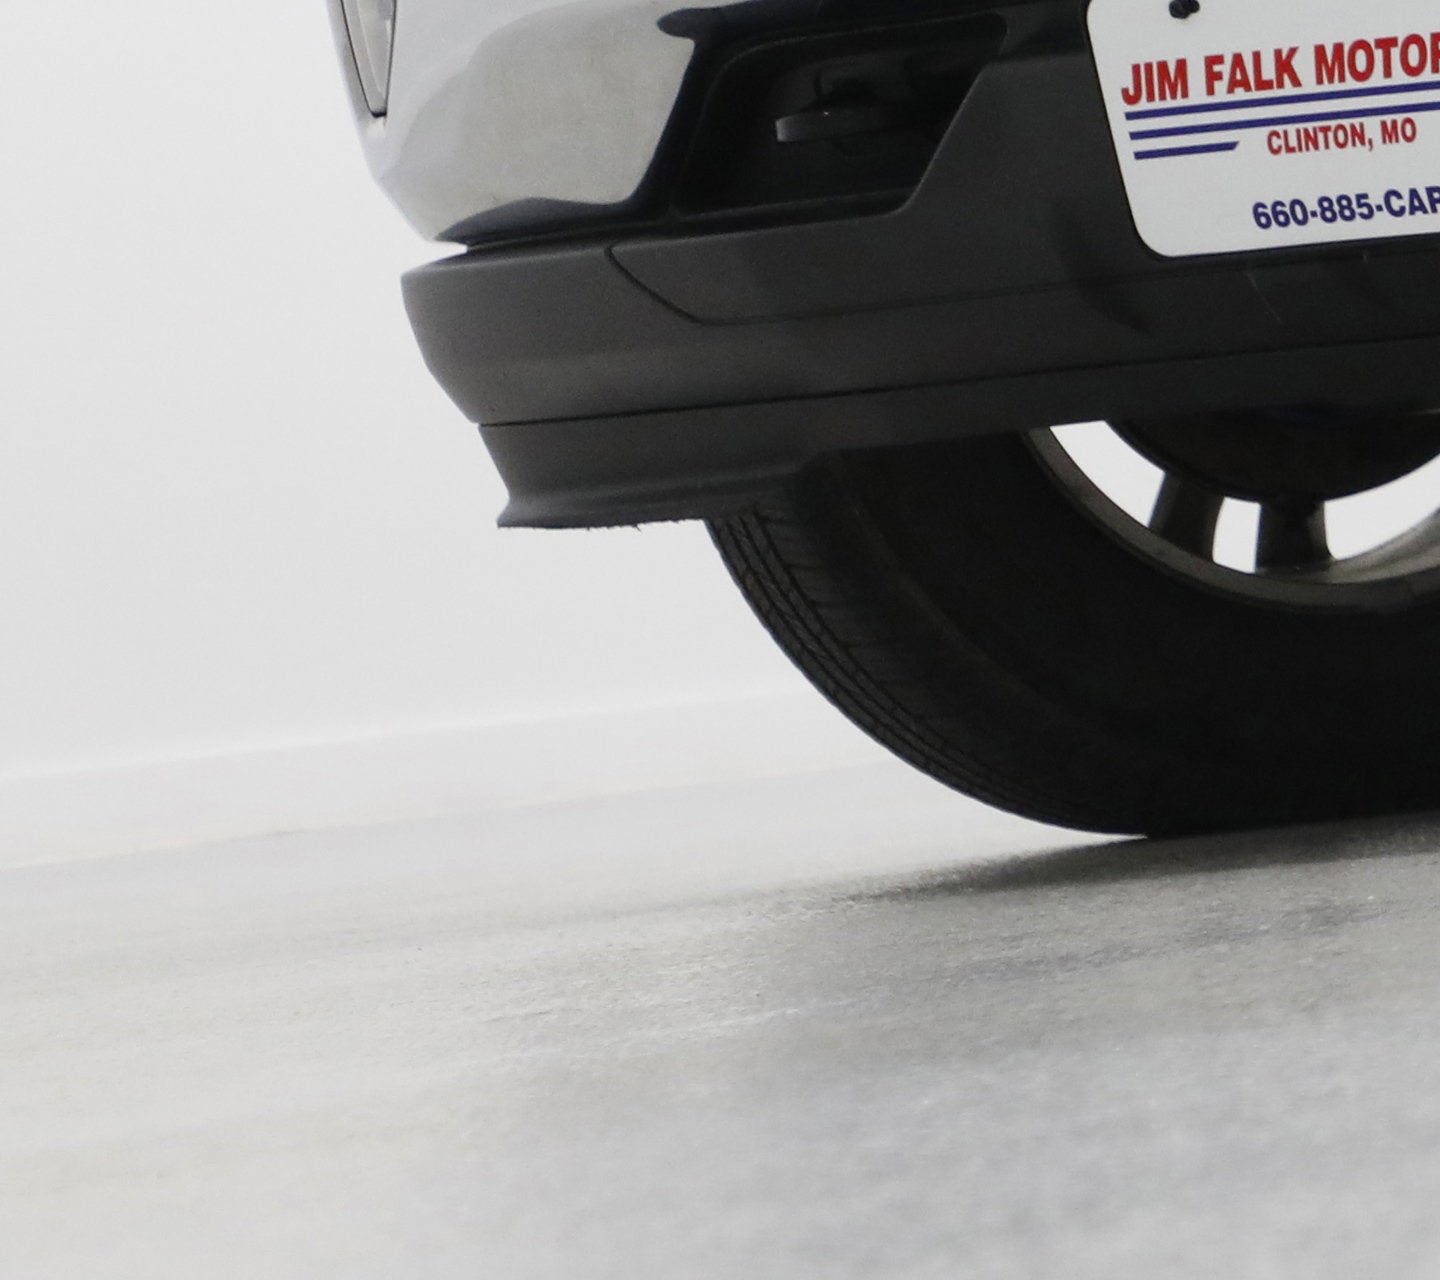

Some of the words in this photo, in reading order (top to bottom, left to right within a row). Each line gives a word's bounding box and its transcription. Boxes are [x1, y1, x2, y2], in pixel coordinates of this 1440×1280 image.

[1121, 58, 1190, 106] JIM
[1204, 47, 1302, 96] FALK
[1266, 122, 1374, 155] CLINTON,
[1381, 117, 1417, 143] MO
